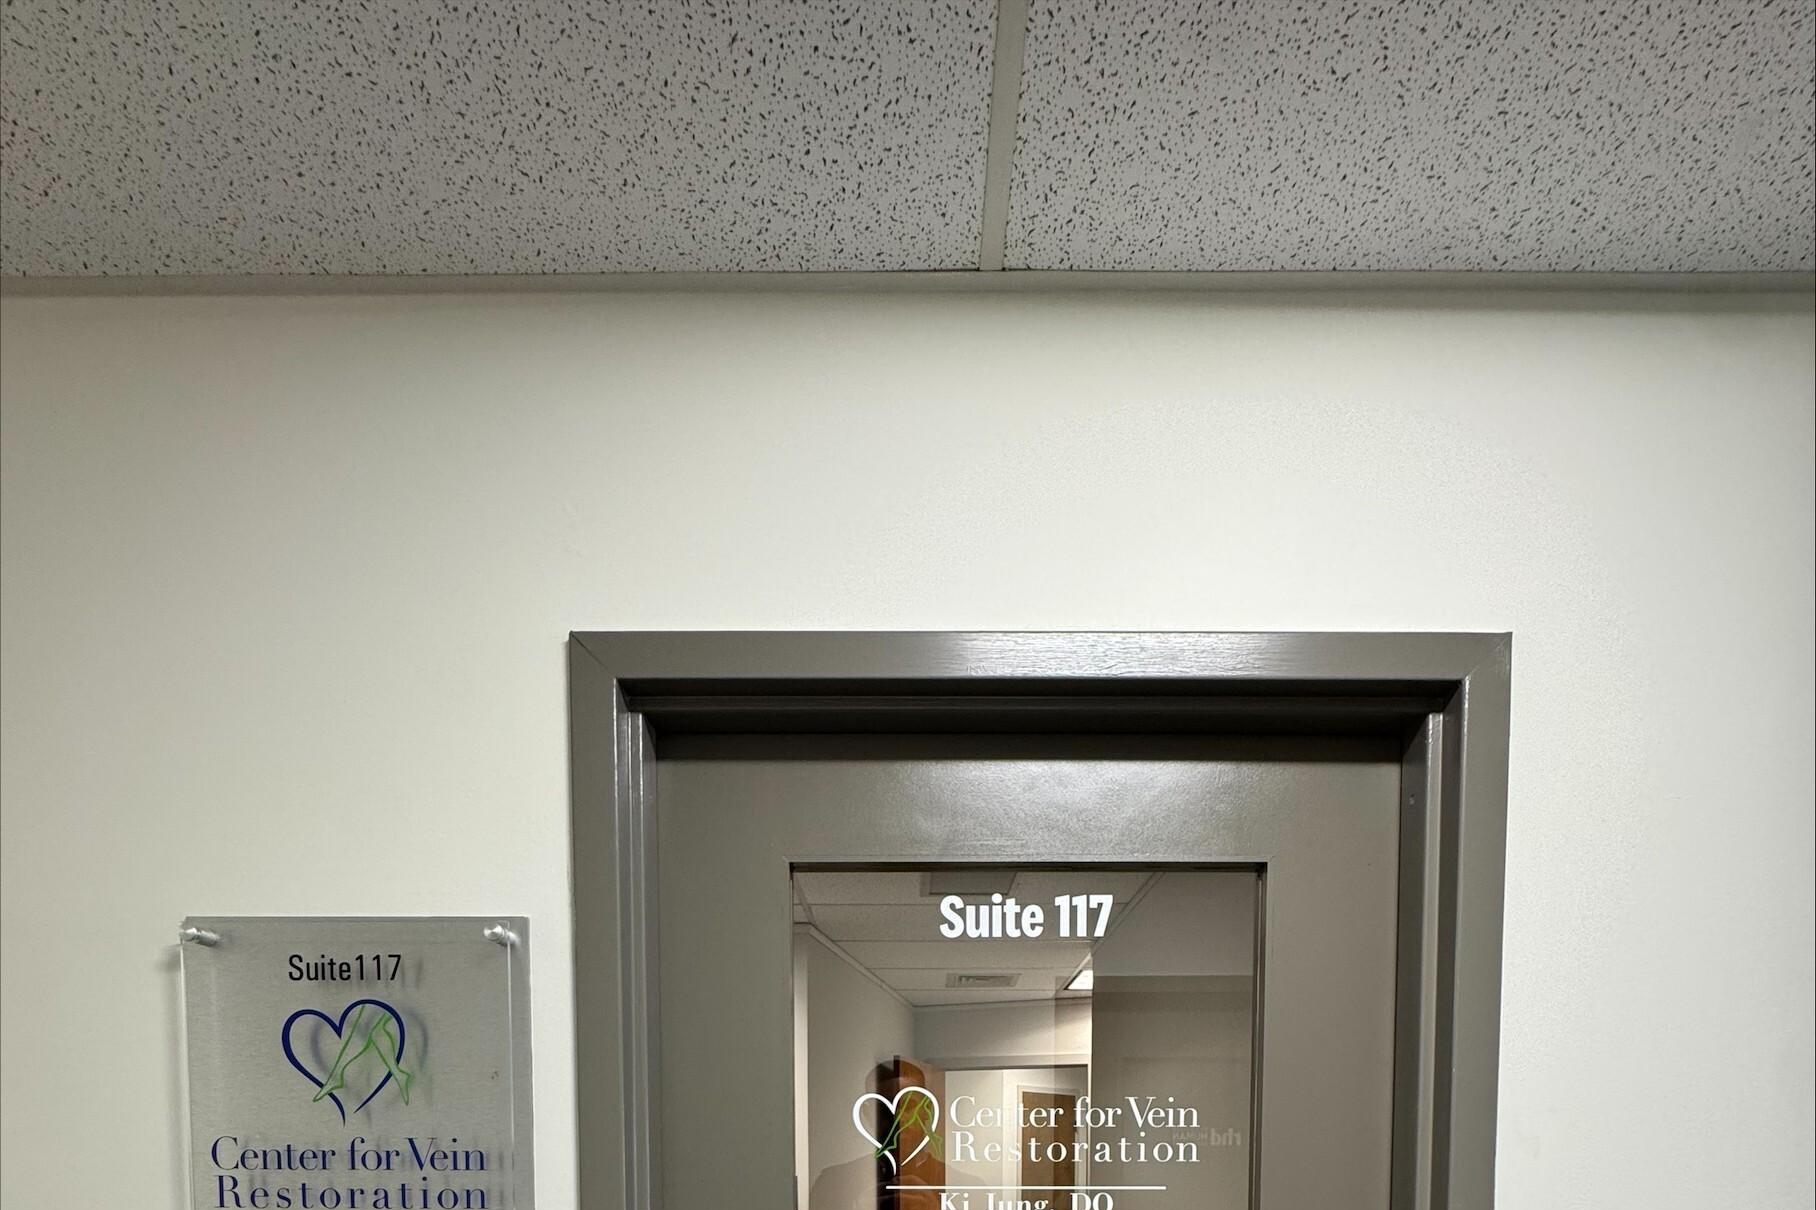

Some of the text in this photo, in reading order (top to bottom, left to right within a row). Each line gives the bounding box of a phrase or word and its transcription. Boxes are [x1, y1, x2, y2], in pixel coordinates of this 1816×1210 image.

[939, 893, 1114, 939] Suite 117
[950, 1096, 1201, 1128] Center for Vein
[211, 1135, 488, 1172] Center for Vein
[951, 1130, 1201, 1164] Restoration
[213, 1175, 490, 1210] Restoration
